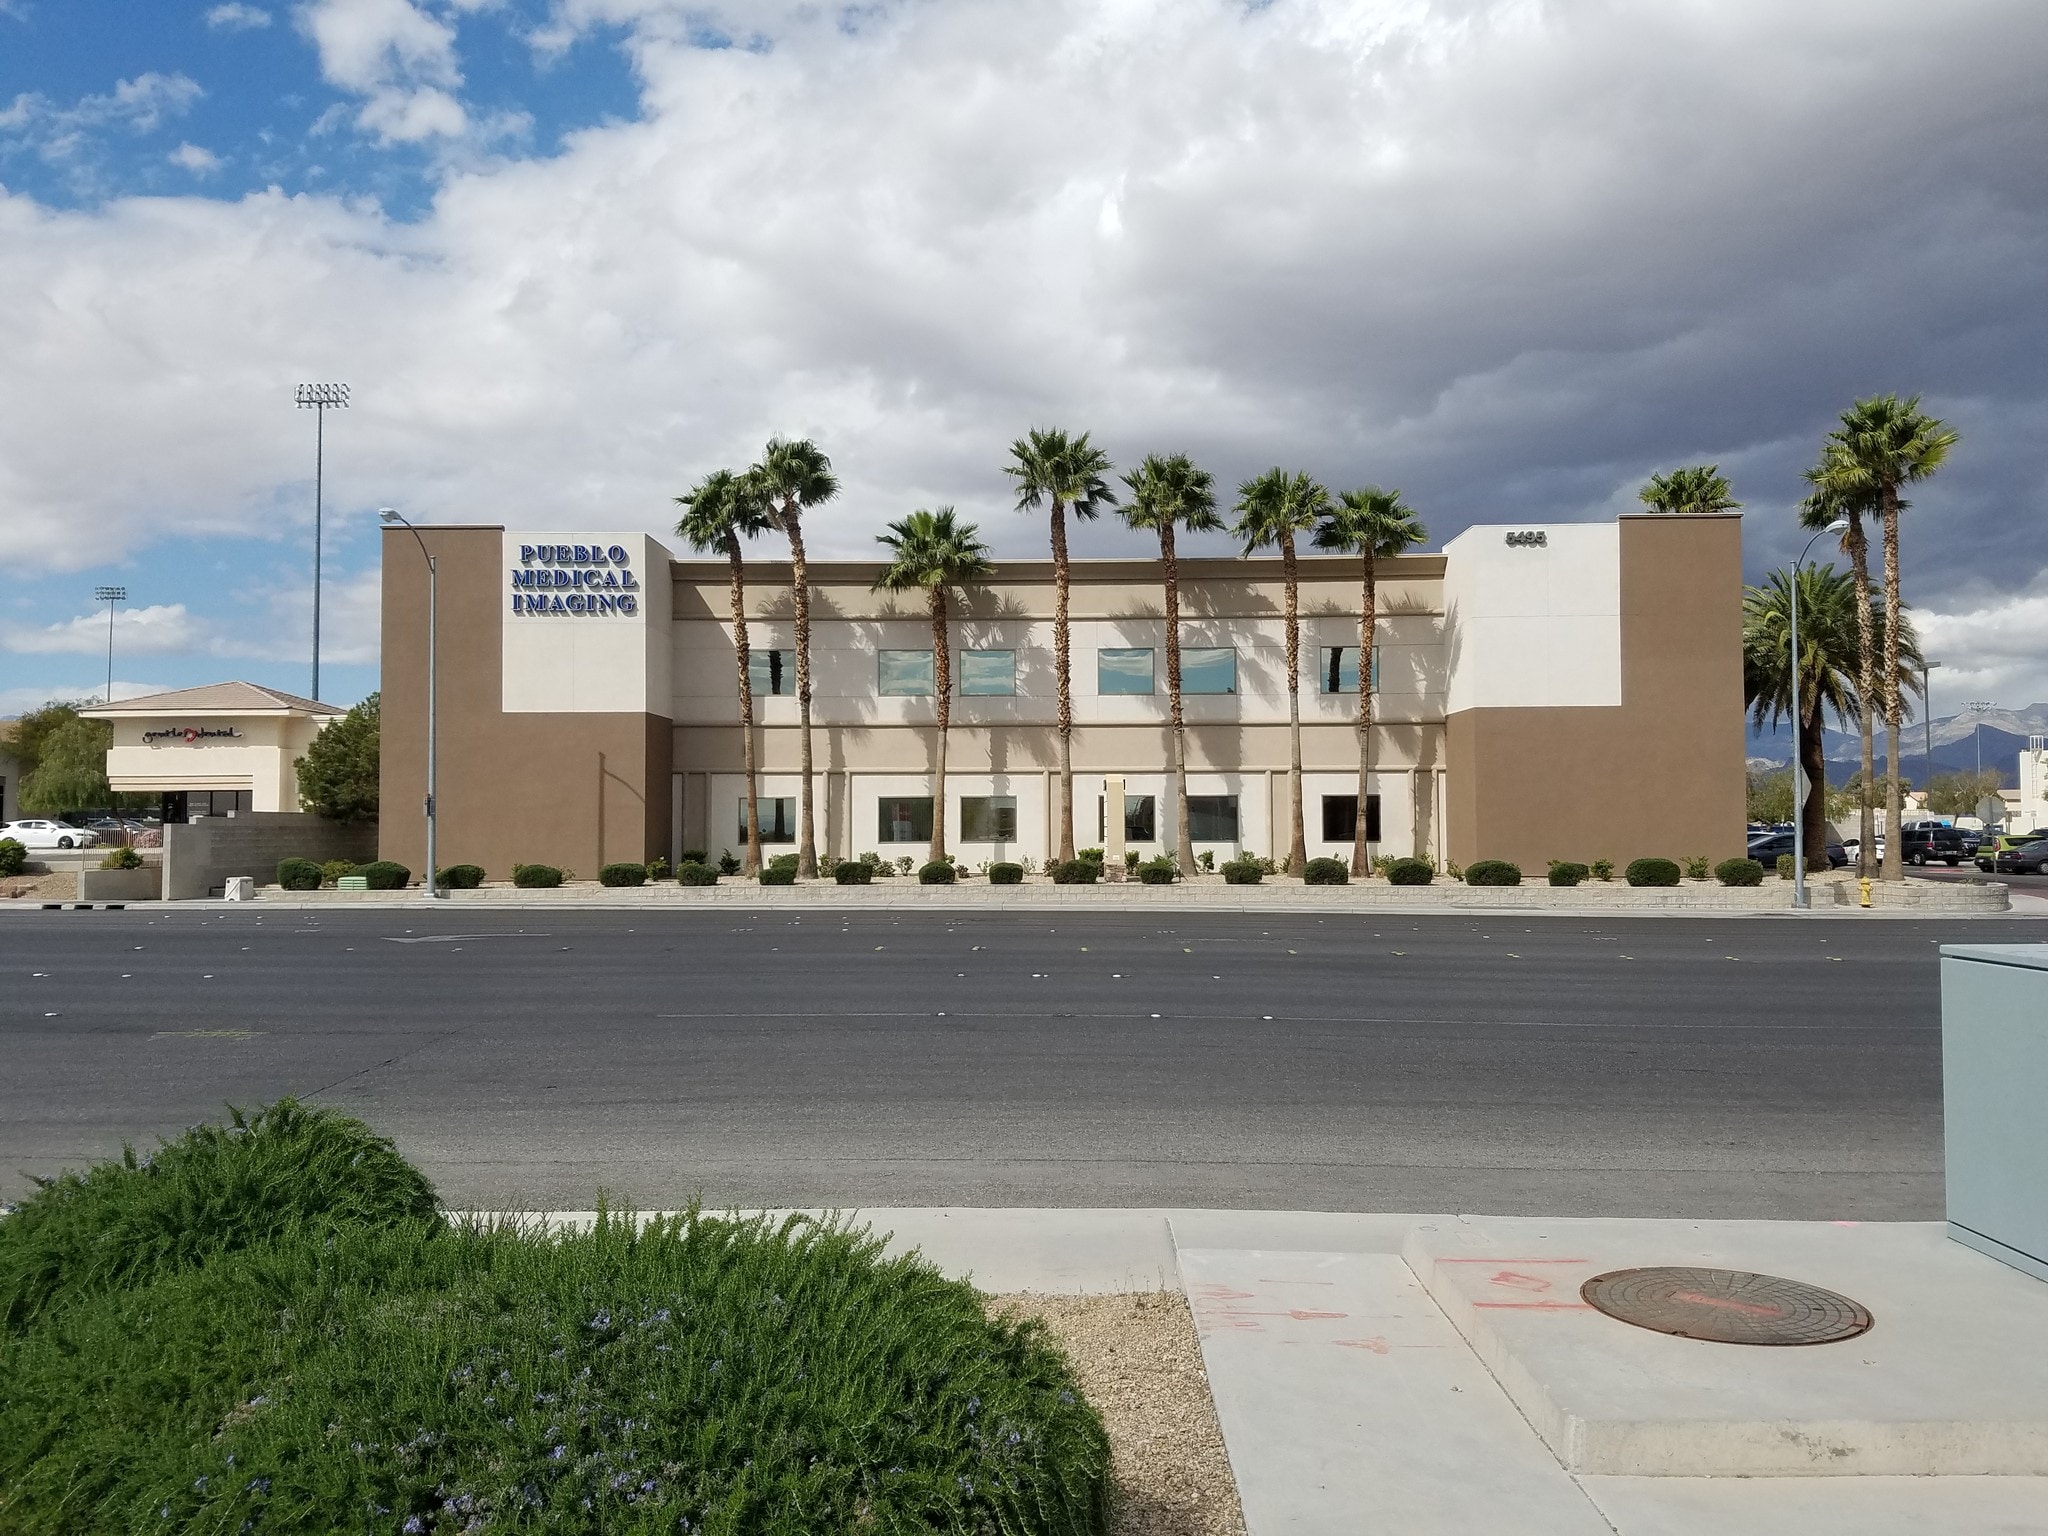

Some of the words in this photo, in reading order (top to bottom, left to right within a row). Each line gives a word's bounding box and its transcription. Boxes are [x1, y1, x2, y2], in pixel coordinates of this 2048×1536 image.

[1506, 531, 1546, 543] 5495
[519, 544, 627, 562] PUEBLO
[511, 569, 636, 587] MEDICAL
[511, 593, 636, 611] IMAGING
